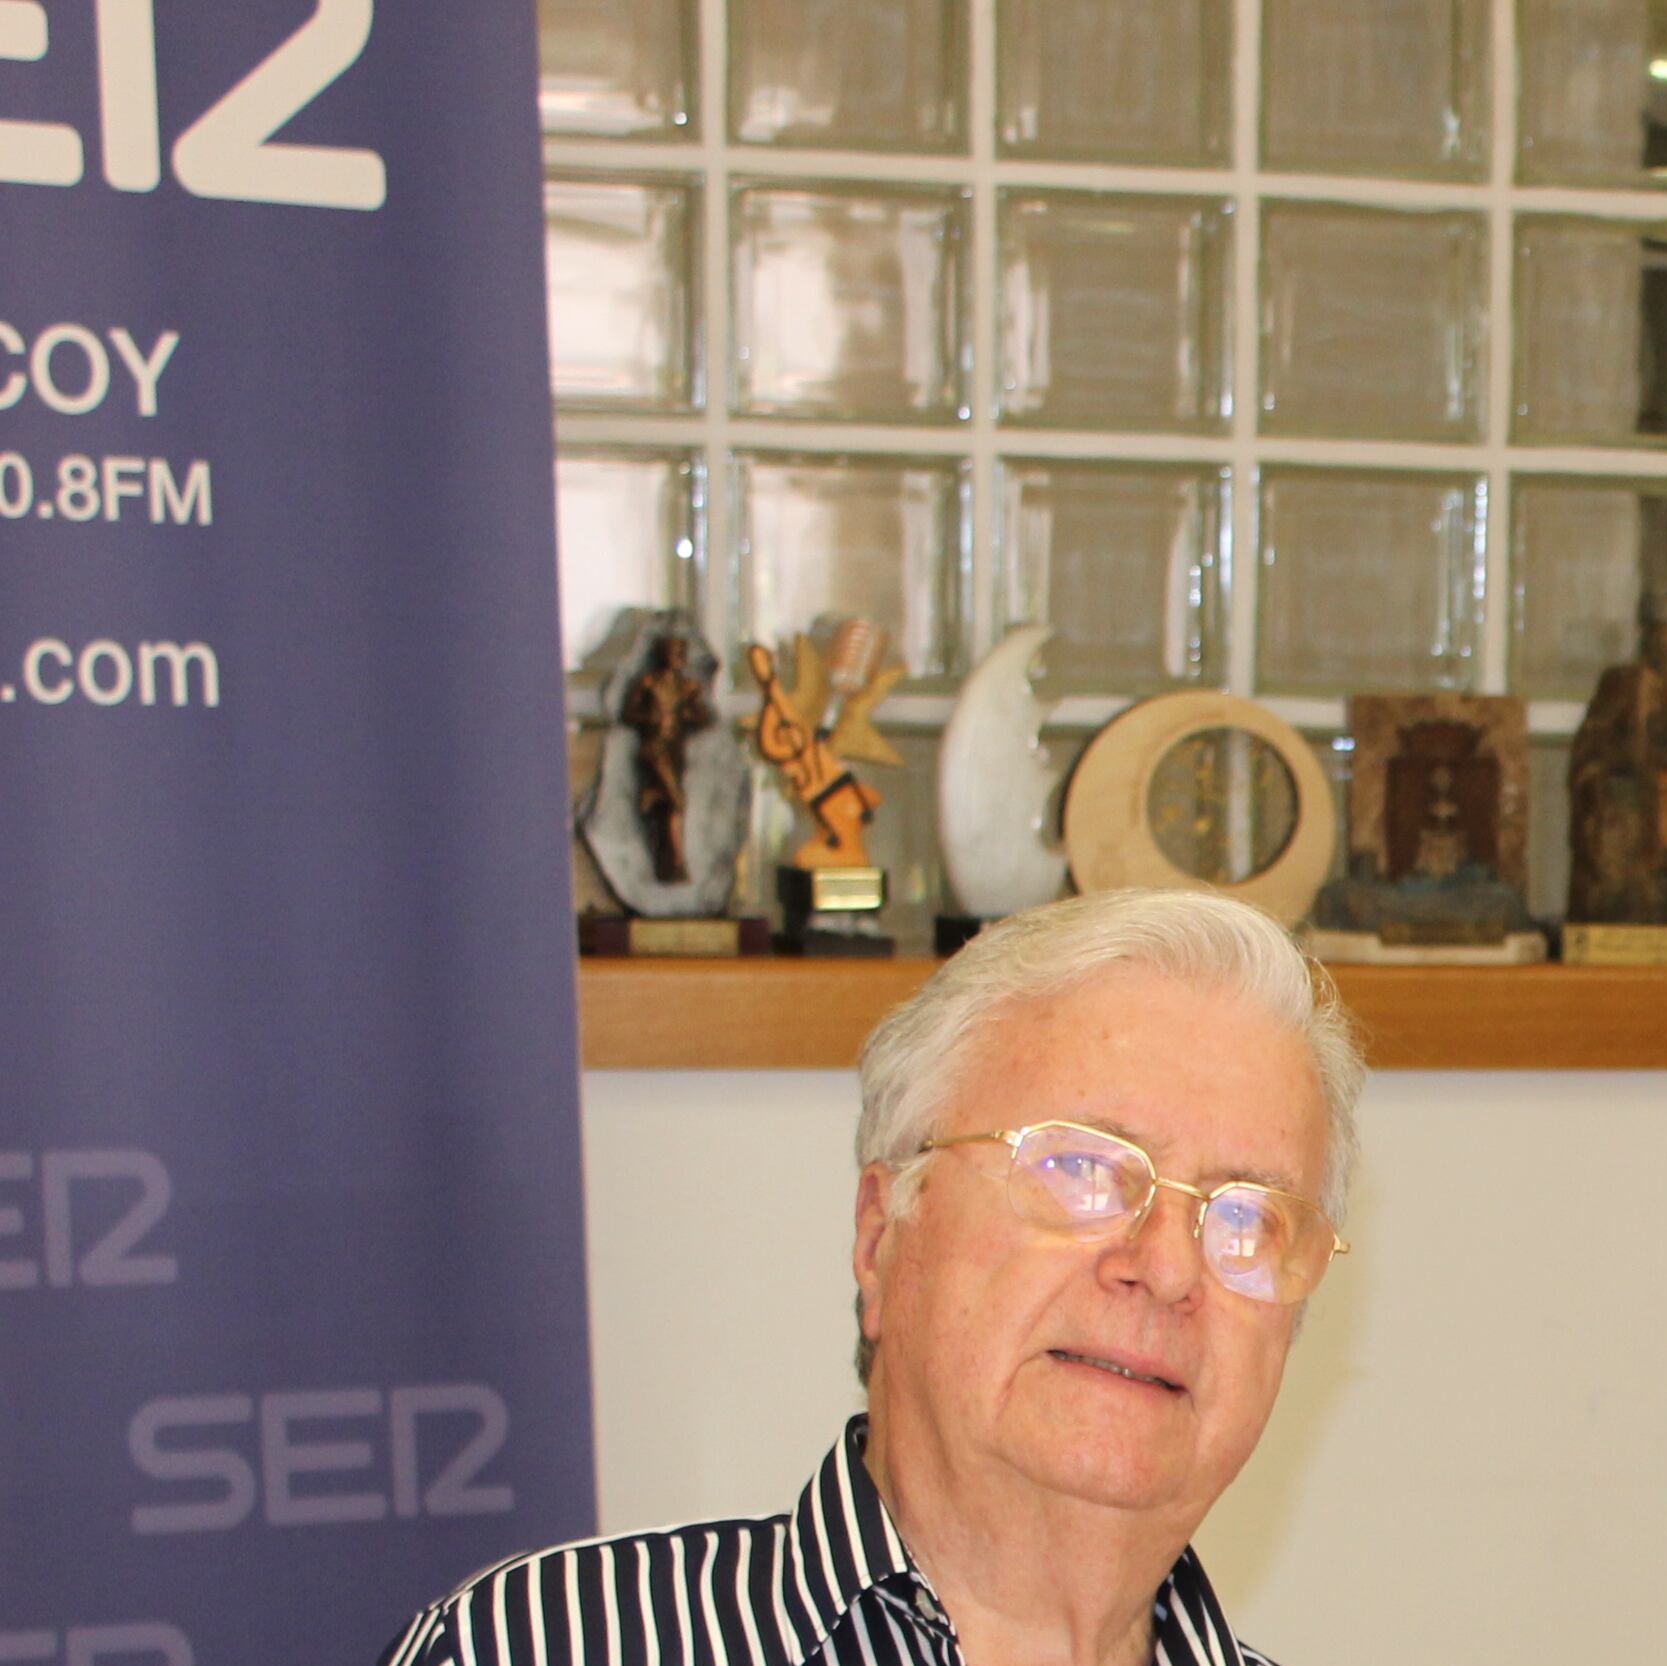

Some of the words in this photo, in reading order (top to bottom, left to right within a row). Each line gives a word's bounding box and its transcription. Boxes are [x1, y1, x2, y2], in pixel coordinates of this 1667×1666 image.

[0, 455, 213, 525] 0.8FM
[0, 637, 220, 708] .com
[129, 1382, 515, 1534] SER
